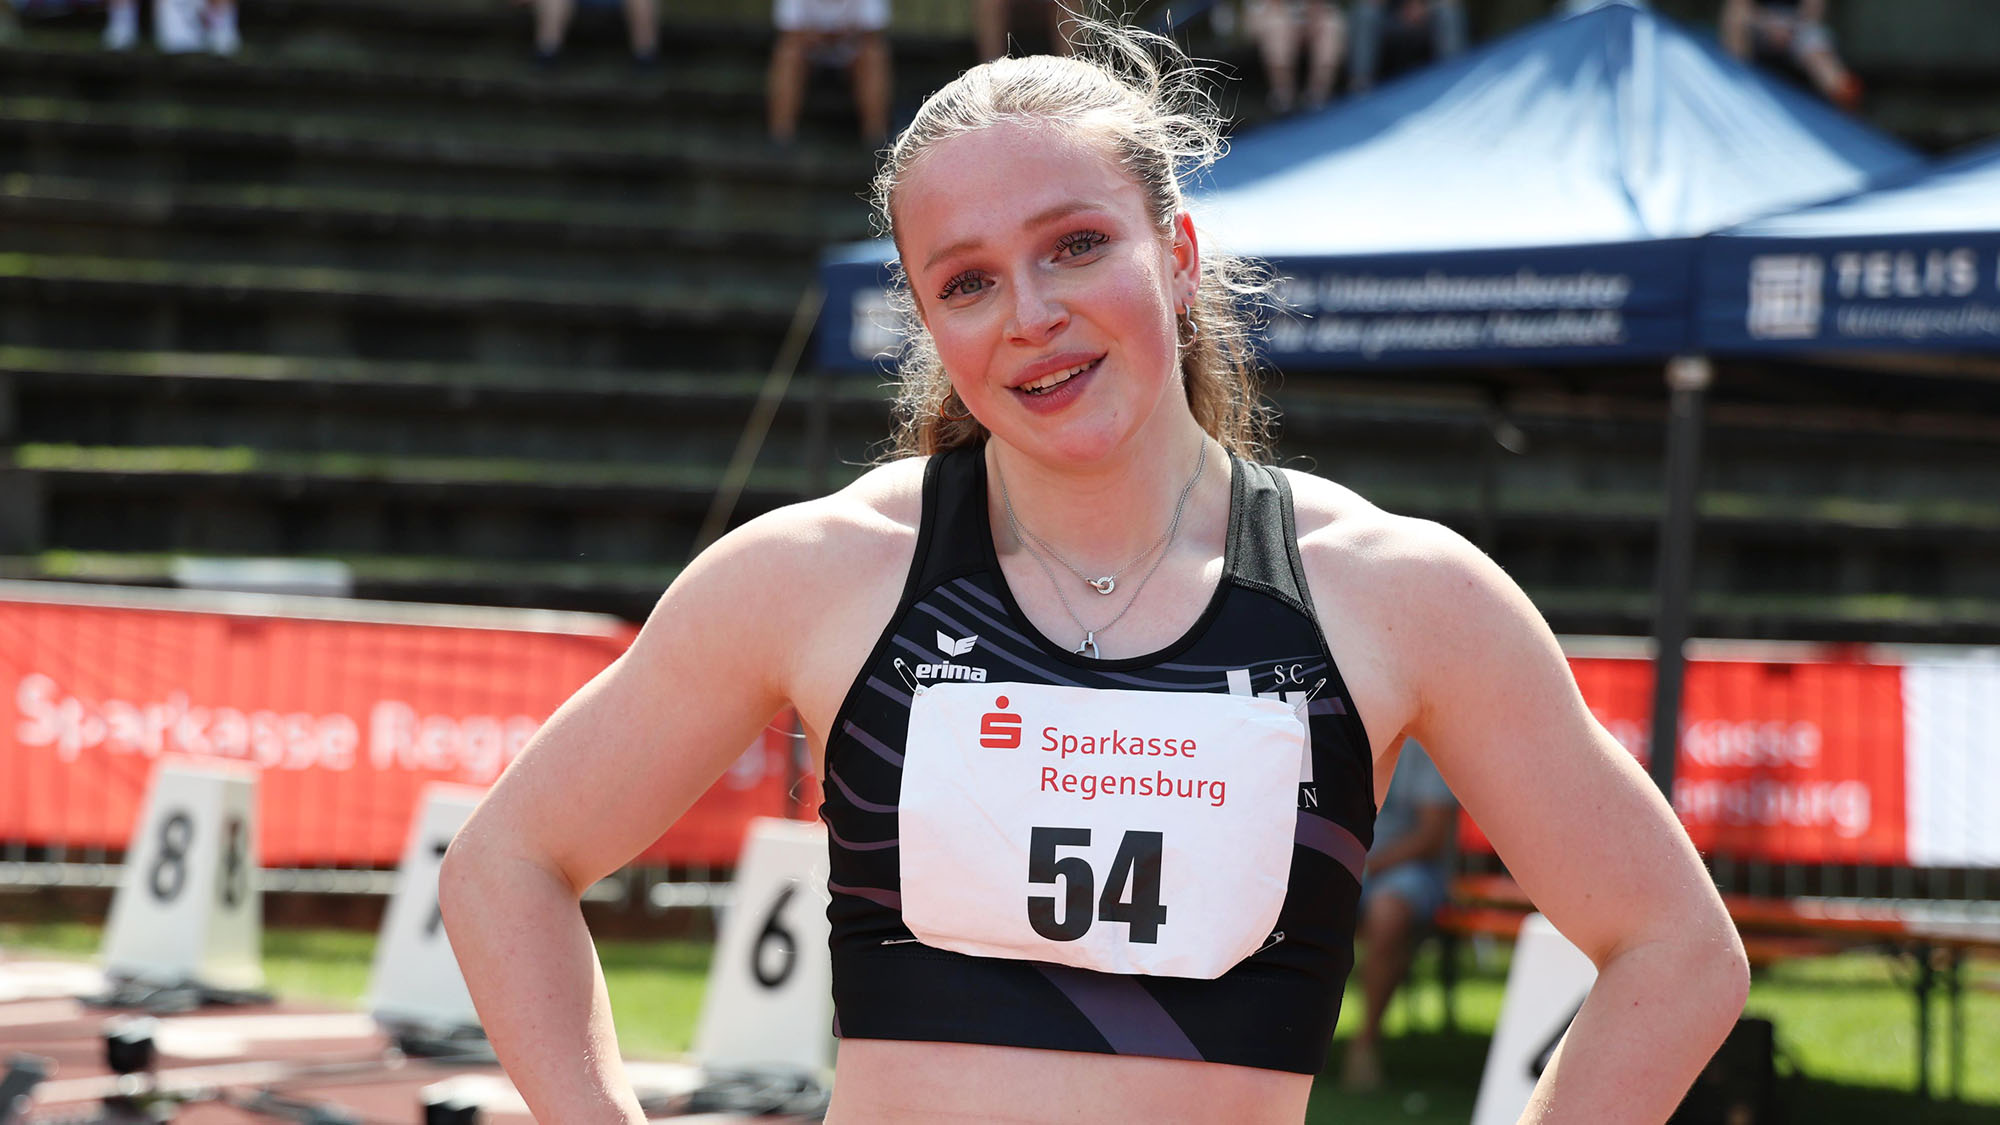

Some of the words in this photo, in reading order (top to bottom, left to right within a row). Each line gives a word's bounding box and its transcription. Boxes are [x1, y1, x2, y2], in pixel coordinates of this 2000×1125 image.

[1834, 250, 1977, 297] TELIS
[916, 660, 987, 682] erima
[1274, 664, 1304, 684] SC
[16, 673, 358, 771] Sparkasse
[1041, 727, 1197, 759] Sparkasse
[1040, 766, 1227, 807] Regensburg
[149, 811, 193, 902] 8
[1027, 826, 1168, 944] 54
[752, 884, 798, 988] 6
